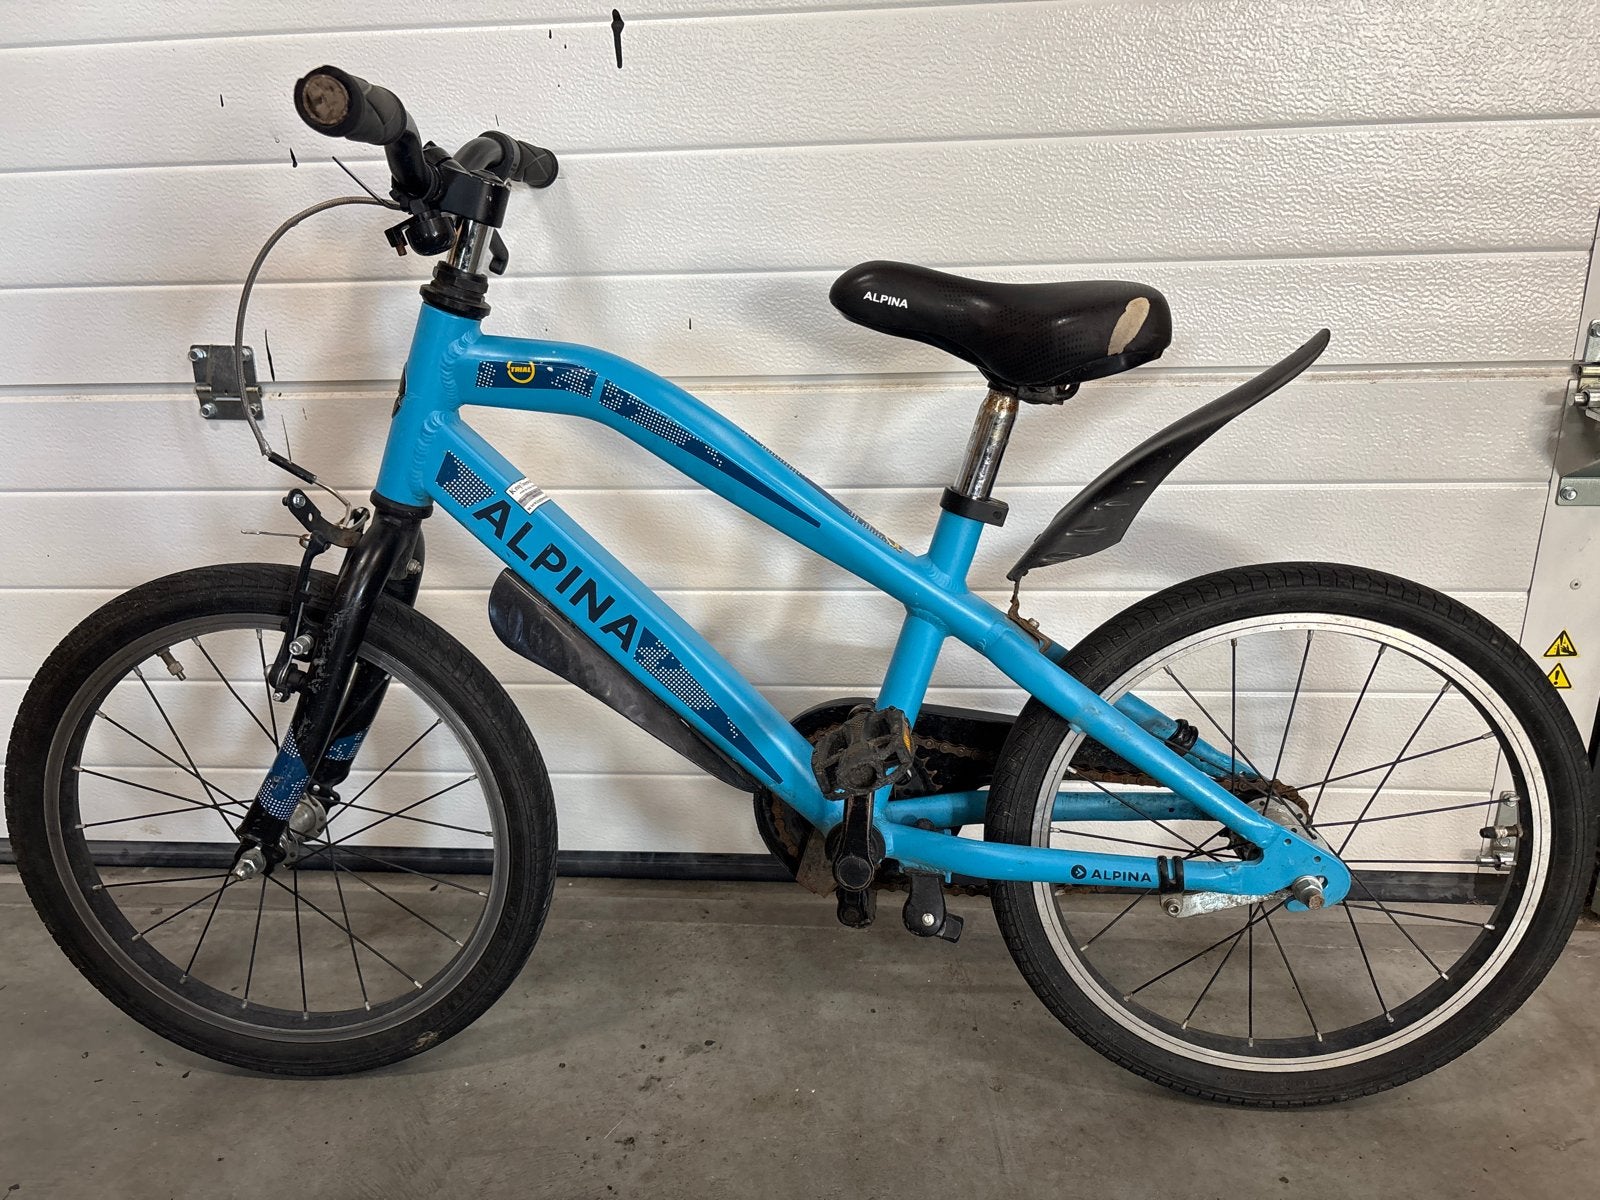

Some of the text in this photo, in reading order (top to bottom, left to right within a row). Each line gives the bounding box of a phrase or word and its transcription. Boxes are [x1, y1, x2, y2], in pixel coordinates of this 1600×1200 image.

[863, 291, 909, 309] ALPINA
[472, 500, 638, 653] ALPINA
[1091, 869, 1152, 883] ALPINA
